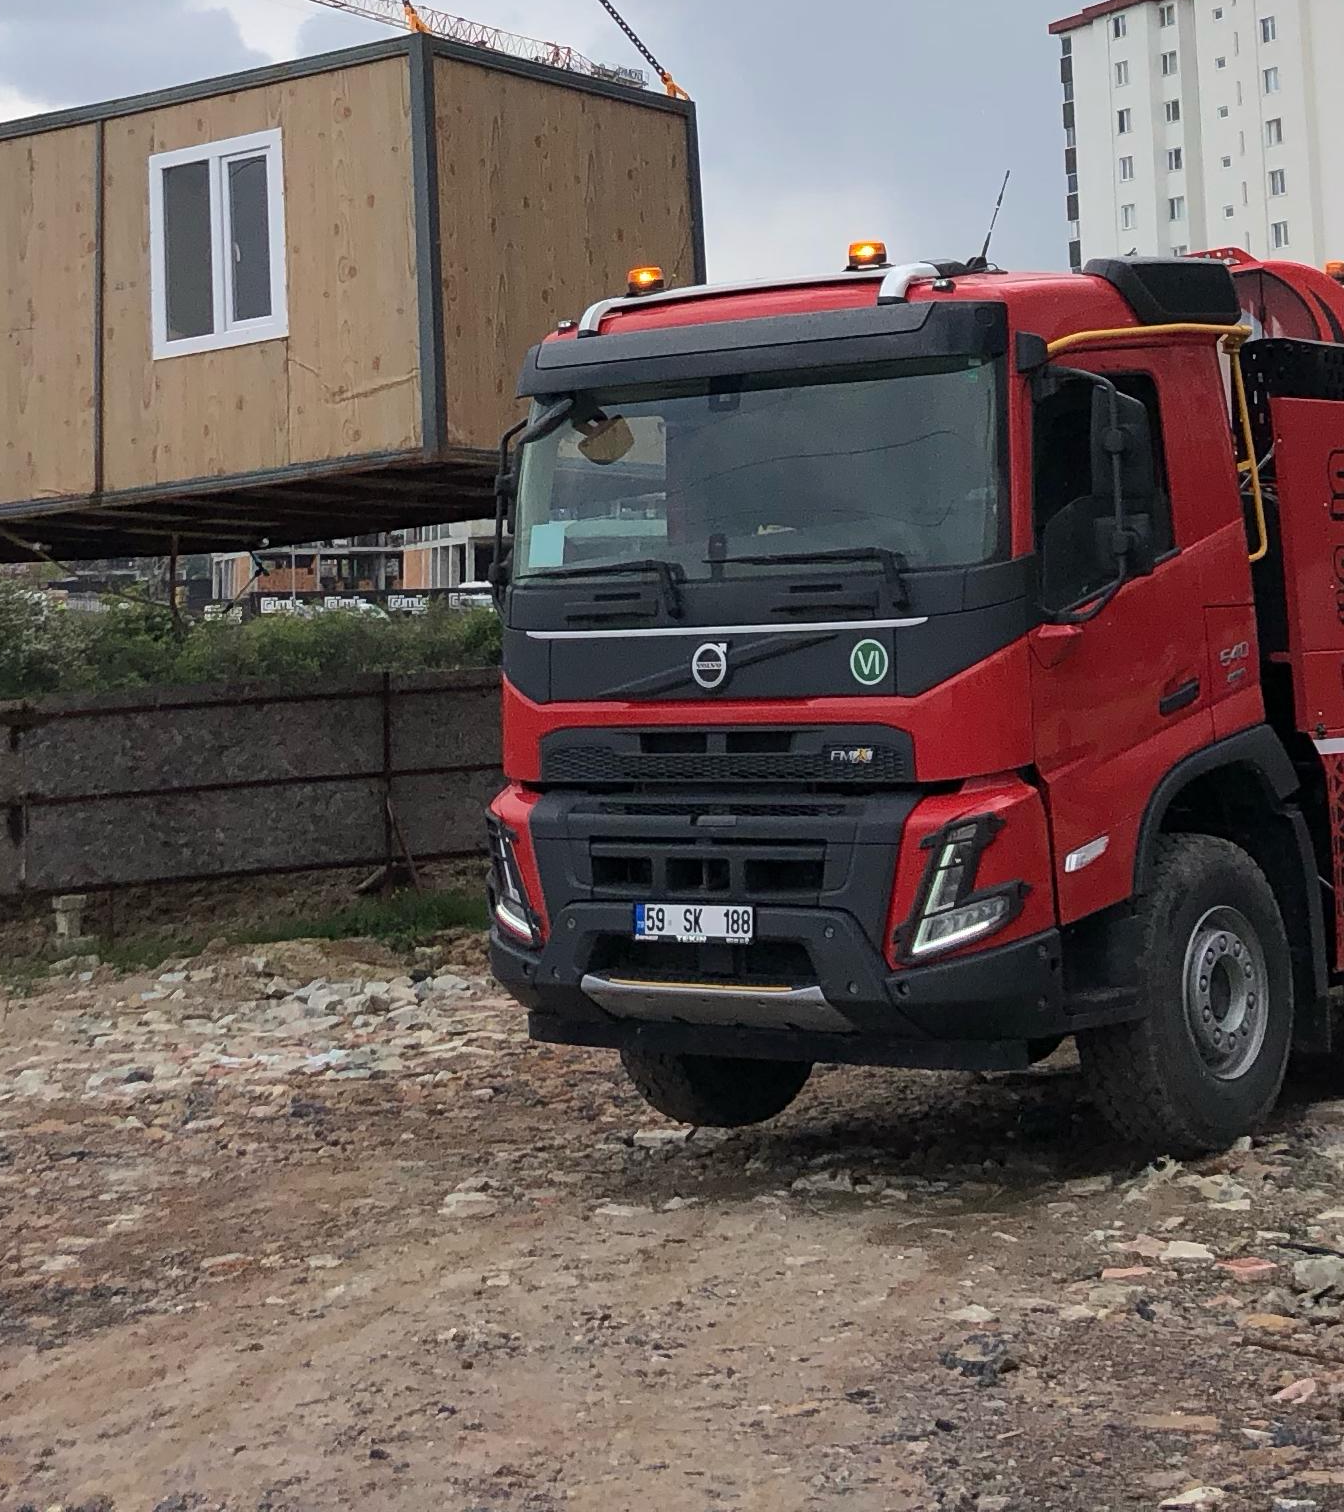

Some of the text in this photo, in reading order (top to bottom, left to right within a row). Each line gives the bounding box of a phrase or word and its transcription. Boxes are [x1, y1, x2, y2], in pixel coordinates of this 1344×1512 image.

[858, 651, 880, 675] VI
[646, 907, 751, 934] 59 SK 188
